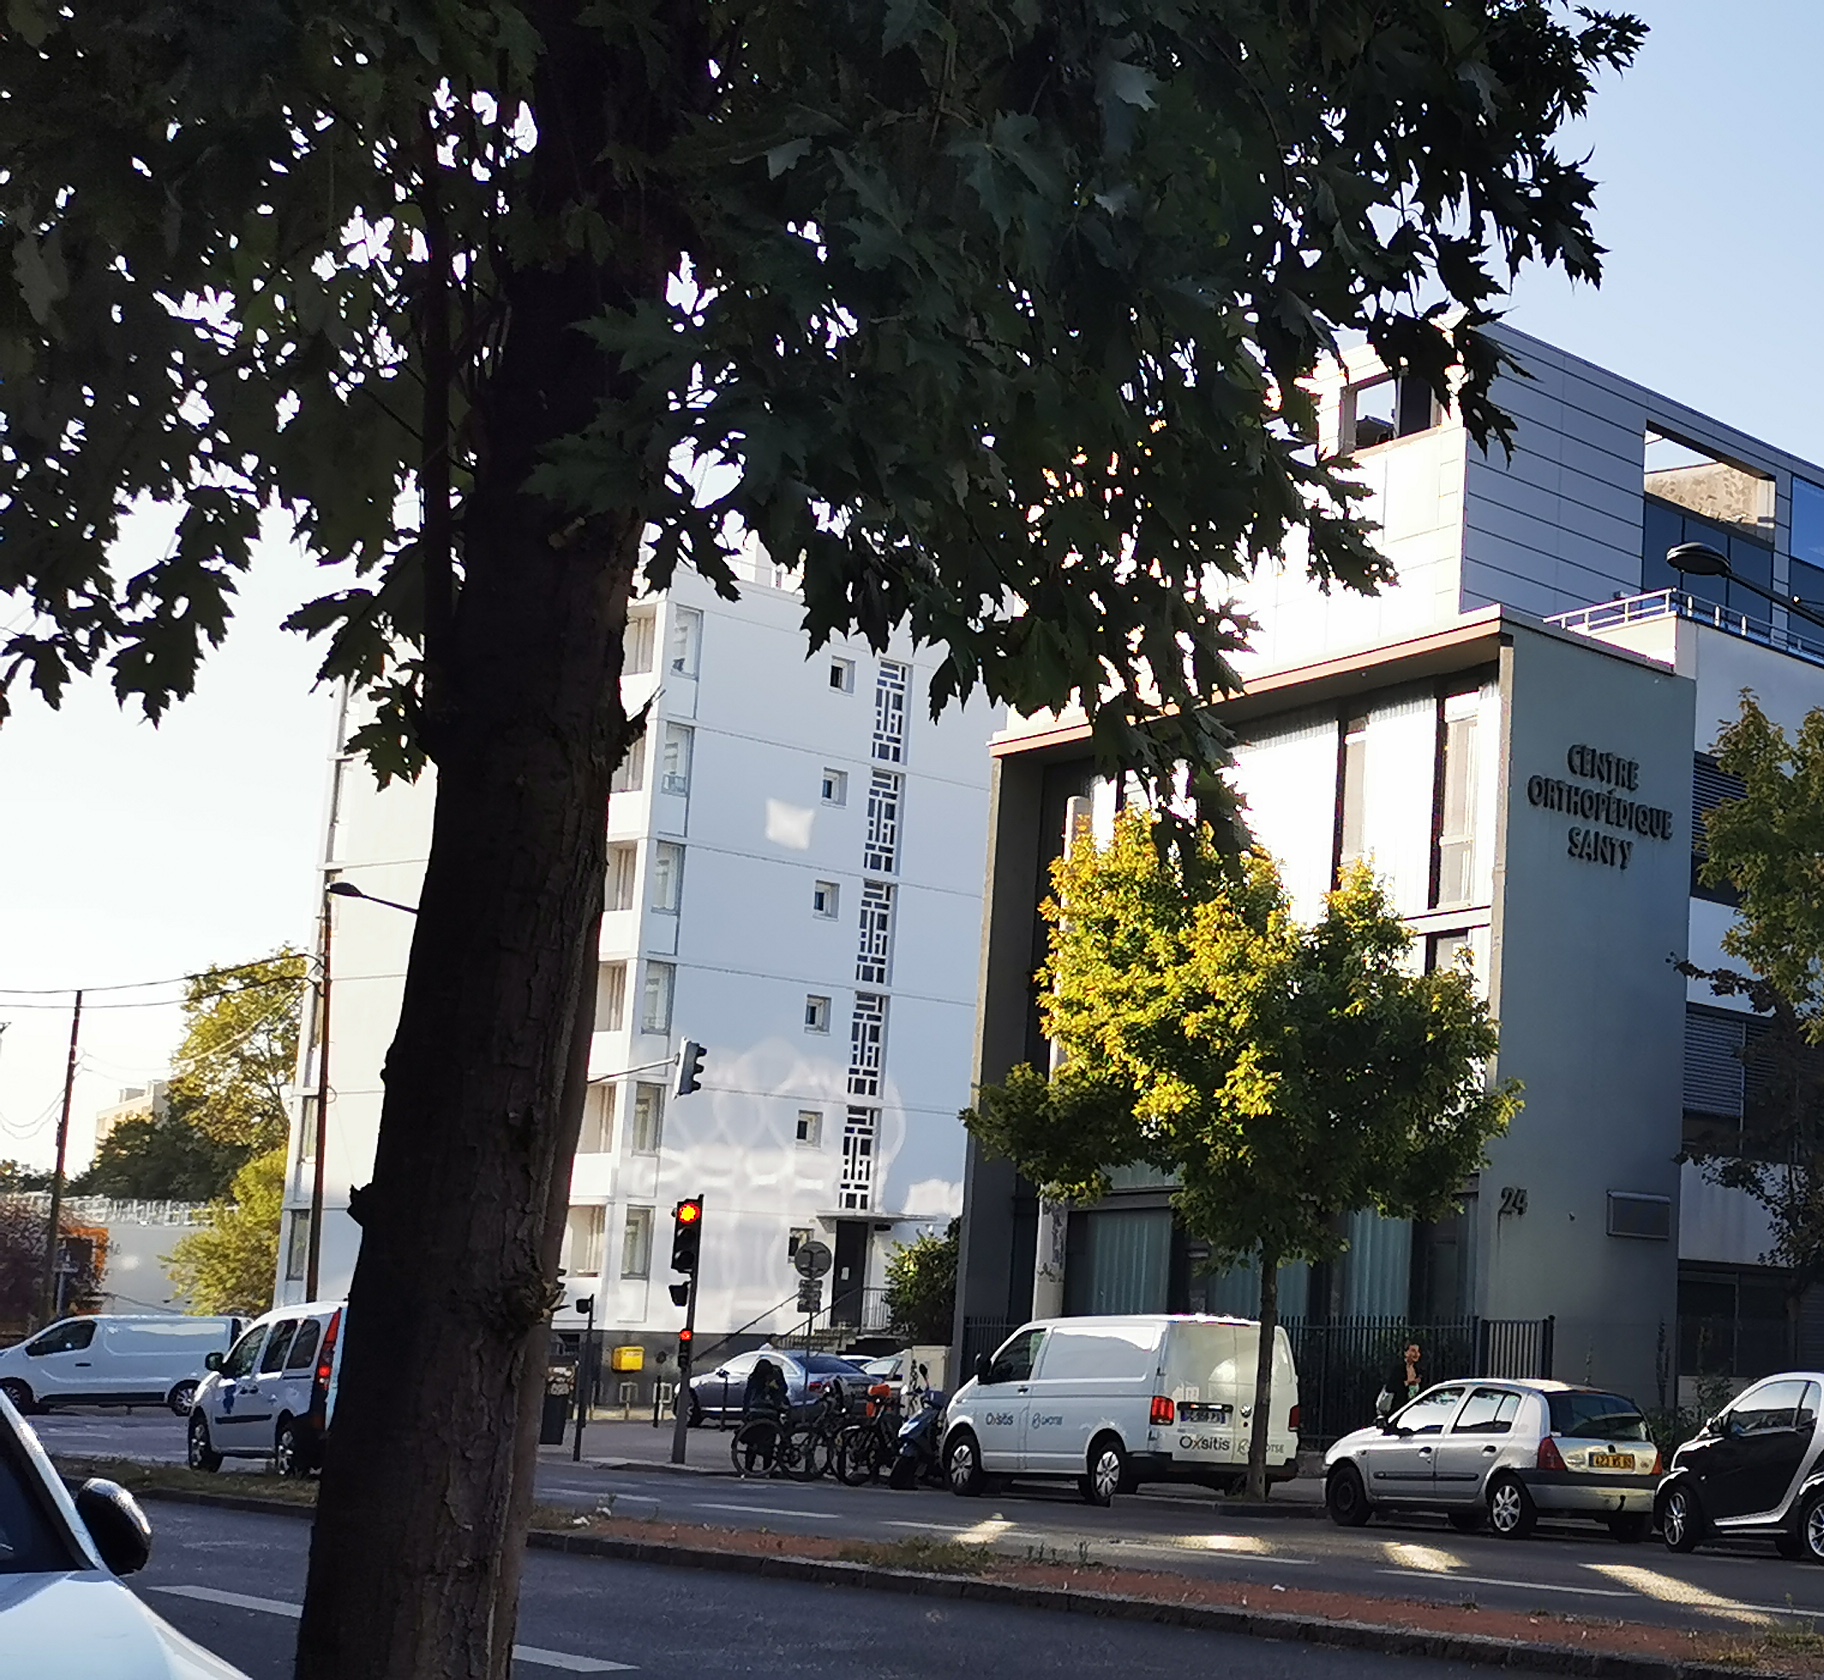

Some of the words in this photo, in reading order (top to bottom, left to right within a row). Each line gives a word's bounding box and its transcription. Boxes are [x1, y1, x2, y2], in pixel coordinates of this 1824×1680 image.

[1567, 744, 1640, 792] CENTRE
[1527, 774, 1674, 841] ORTHOPÉDIQUE
[1567, 826, 1634, 871] SANTY
[1179, 1435, 1231, 1451] Oxsitis
